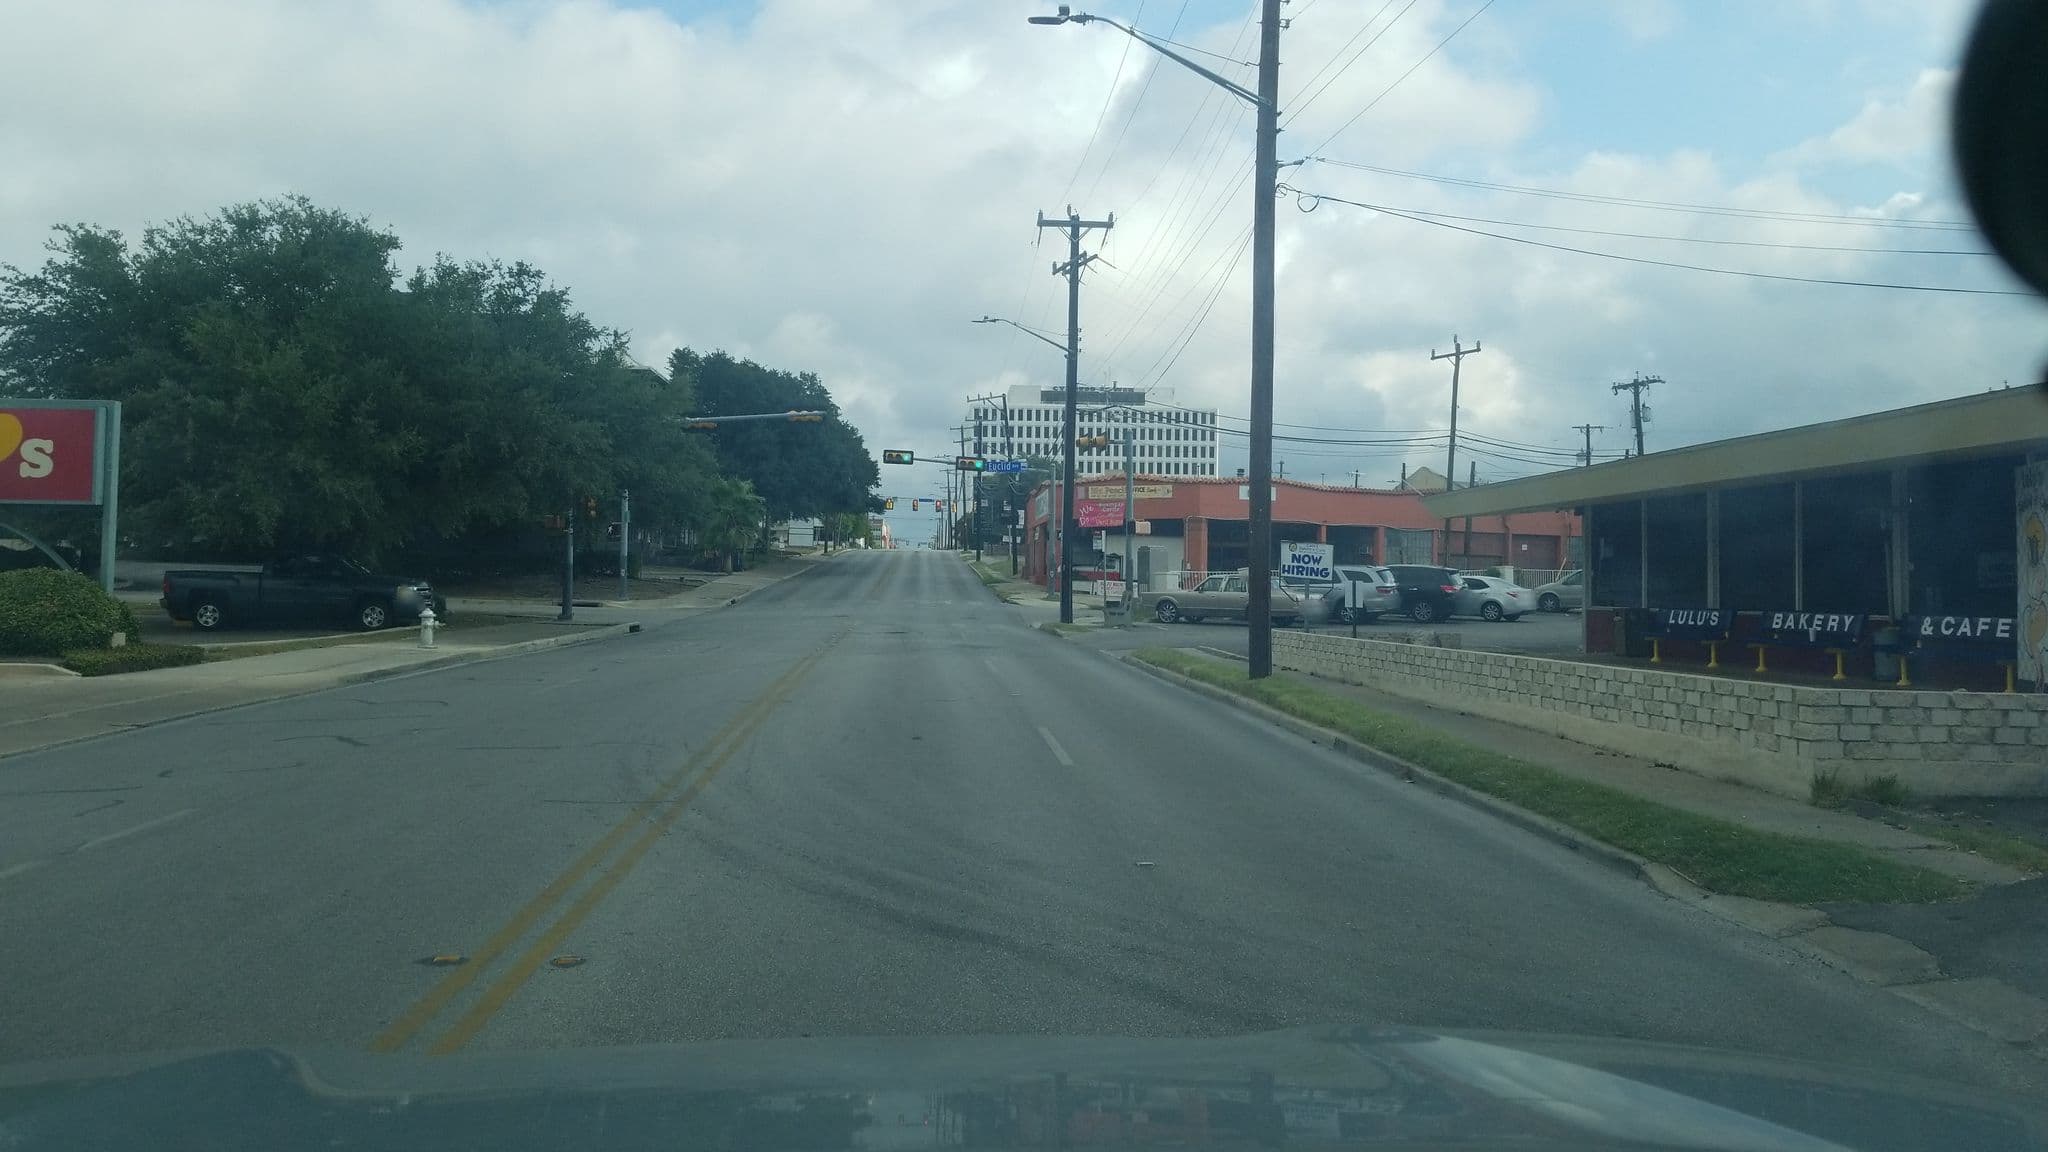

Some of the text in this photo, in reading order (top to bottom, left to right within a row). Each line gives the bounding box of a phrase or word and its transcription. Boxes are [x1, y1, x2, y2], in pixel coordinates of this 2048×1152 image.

[988, 462, 1011, 471] Euclid
[1291, 553, 1323, 566] NOW
[1281, 564, 1330, 578] HIRING
[1668, 608, 2013, 639] LULU'S BAKERY & CAFE
